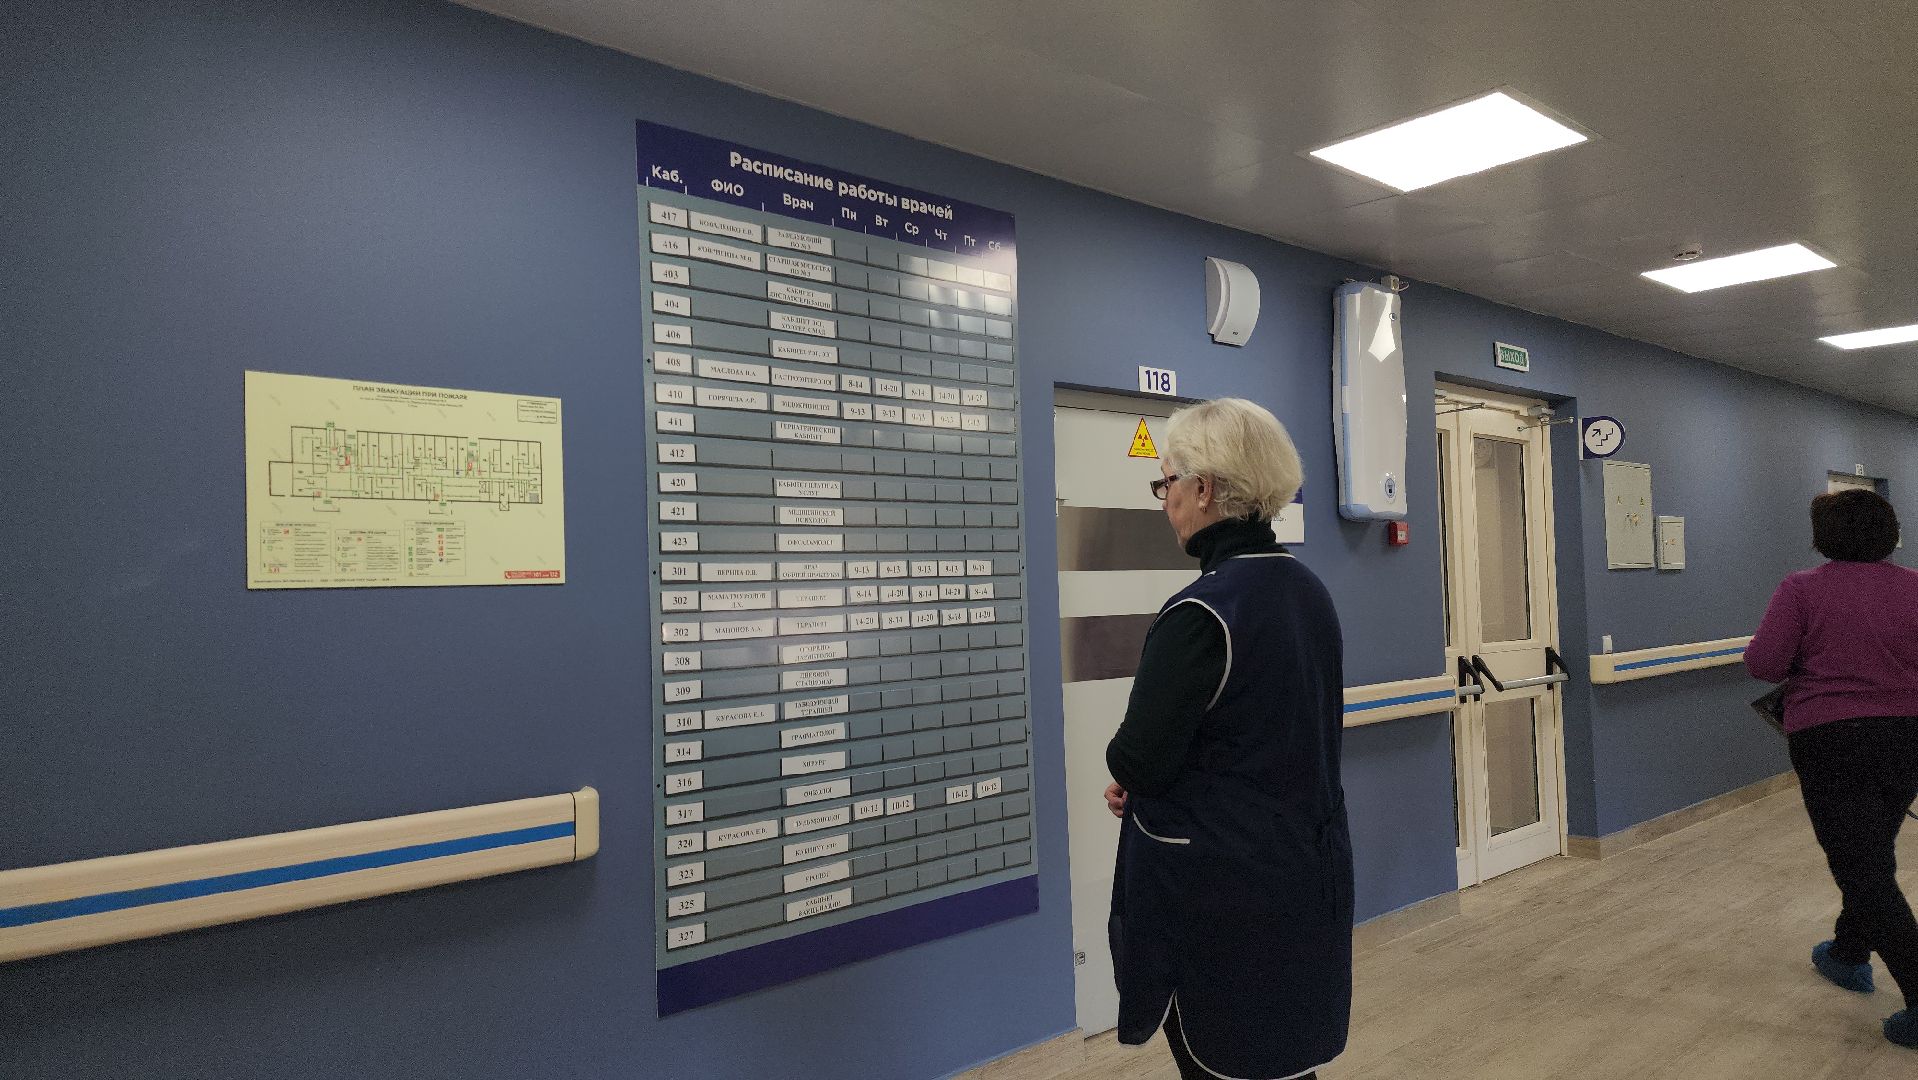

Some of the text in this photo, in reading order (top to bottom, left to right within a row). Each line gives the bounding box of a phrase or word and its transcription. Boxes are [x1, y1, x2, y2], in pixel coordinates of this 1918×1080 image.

[651, 165, 683, 184] Каб.
[711, 178, 744, 197] ФИО
[729, 151, 953, 221] Расписание работы врачей
[783, 193, 814, 212] Врач
[661, 211, 677, 221] 417
[841, 206, 857, 222] Пн
[875, 214, 888, 228] Вт
[904, 222, 919, 236] Ср
[935, 228, 948, 242] Чт
[662, 241, 678, 250] 416
[964, 234, 976, 247] Пт
[988, 239, 1001, 251] Сб
[663, 270, 679, 279] 403
[664, 299, 679, 309] 404
[665, 329, 681, 339] 406
[1500, 349, 1524, 365] ВЫХОД
[665, 358, 681, 367] 408
[848, 379, 863, 389] 8-14
[1145, 369, 1171, 393] 118
[879, 383, 898, 393] 14-20
[376, 388, 422, 397] ЭВАКУАЦИИ
[438, 392, 468, 400] ПОЖАРЕ
[667, 389, 683, 399] 410
[850, 408, 866, 416] 9-13
[882, 410, 896, 418] 9-13
[667, 417, 682, 427] 411
[669, 449, 685, 458] 412
[669, 478, 686, 487] 420
[670, 506, 686, 516] 421
[671, 537, 688, 546] 423
[671, 566, 687, 577] 301
[854, 566, 870, 574] 9-13
[917, 565, 932, 573] 9-13
[918, 590, 932, 598] 8-14
[672, 596, 688, 606] 302
[916, 614, 934, 623] 14-20
[975, 610, 991, 619] 14-20
[673, 628, 689, 637] 302
[674, 656, 691, 666] 308
[675, 686, 691, 697] 309
[676, 718, 692, 727] 310
[676, 747, 691, 757] 314
[677, 777, 692, 787] 316
[678, 809, 694, 819] 317
[678, 839, 694, 849] 320
[678, 869, 694, 880] 323
[678, 899, 695, 910] 325
[678, 931, 694, 942] 327
